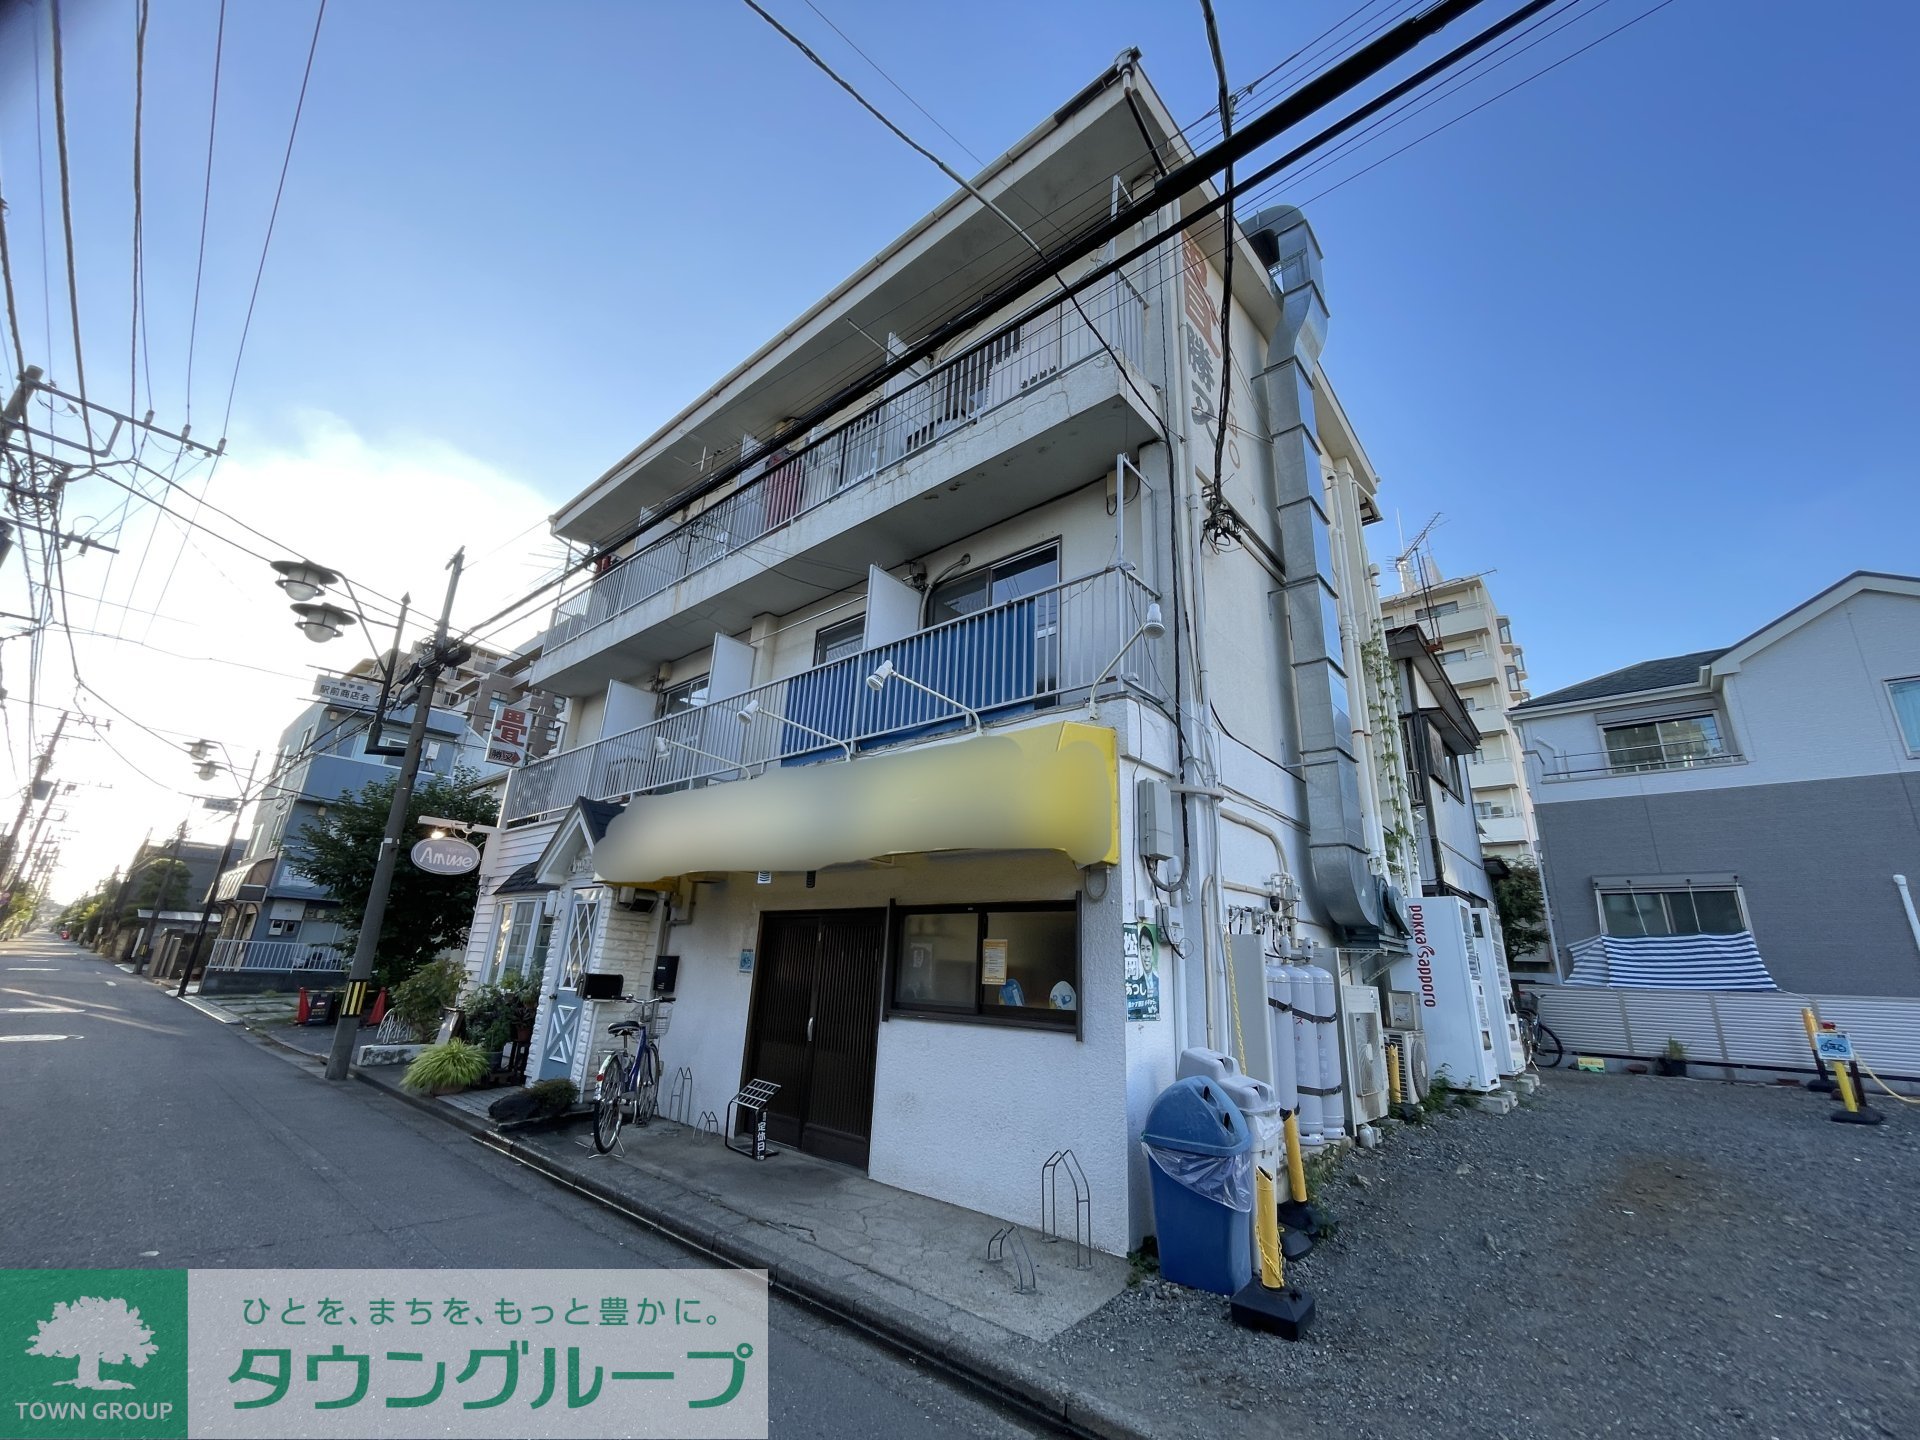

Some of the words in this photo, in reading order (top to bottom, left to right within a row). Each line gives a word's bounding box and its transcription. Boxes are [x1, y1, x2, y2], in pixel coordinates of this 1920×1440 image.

[320, 684, 370, 702] 駅前商店会
[495, 707, 528, 748] 畳
[420, 846, 473, 868] Amuse
